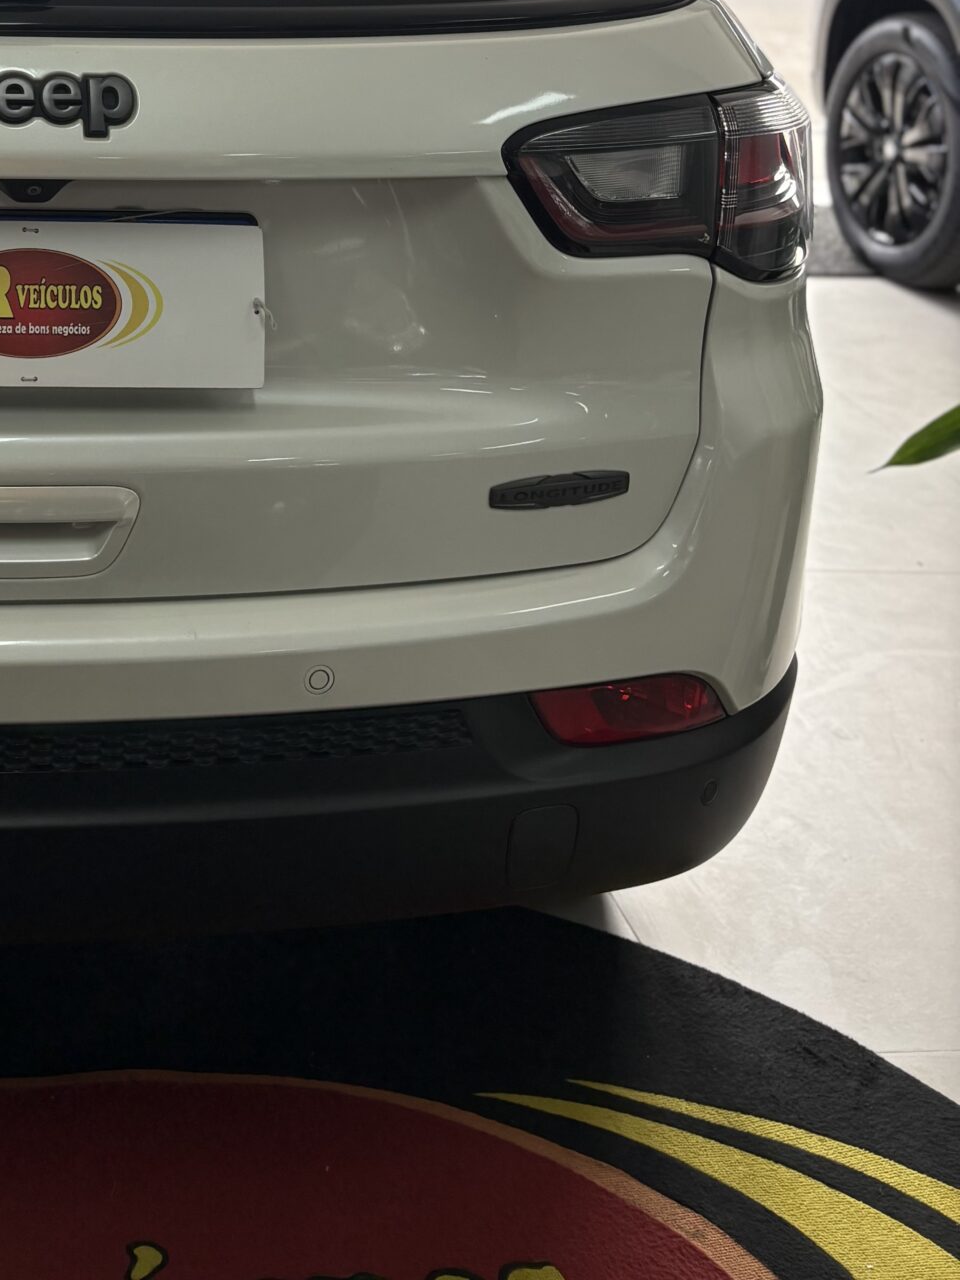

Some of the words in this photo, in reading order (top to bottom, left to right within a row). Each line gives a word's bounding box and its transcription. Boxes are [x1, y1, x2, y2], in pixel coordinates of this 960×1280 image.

[16, 278, 103, 311] VEÍCULOS
[15, 322, 27, 335] de
[28, 322, 50, 336] bons
[52, 322, 91, 337] negócios
[499, 479, 623, 504] LONGITUDE
